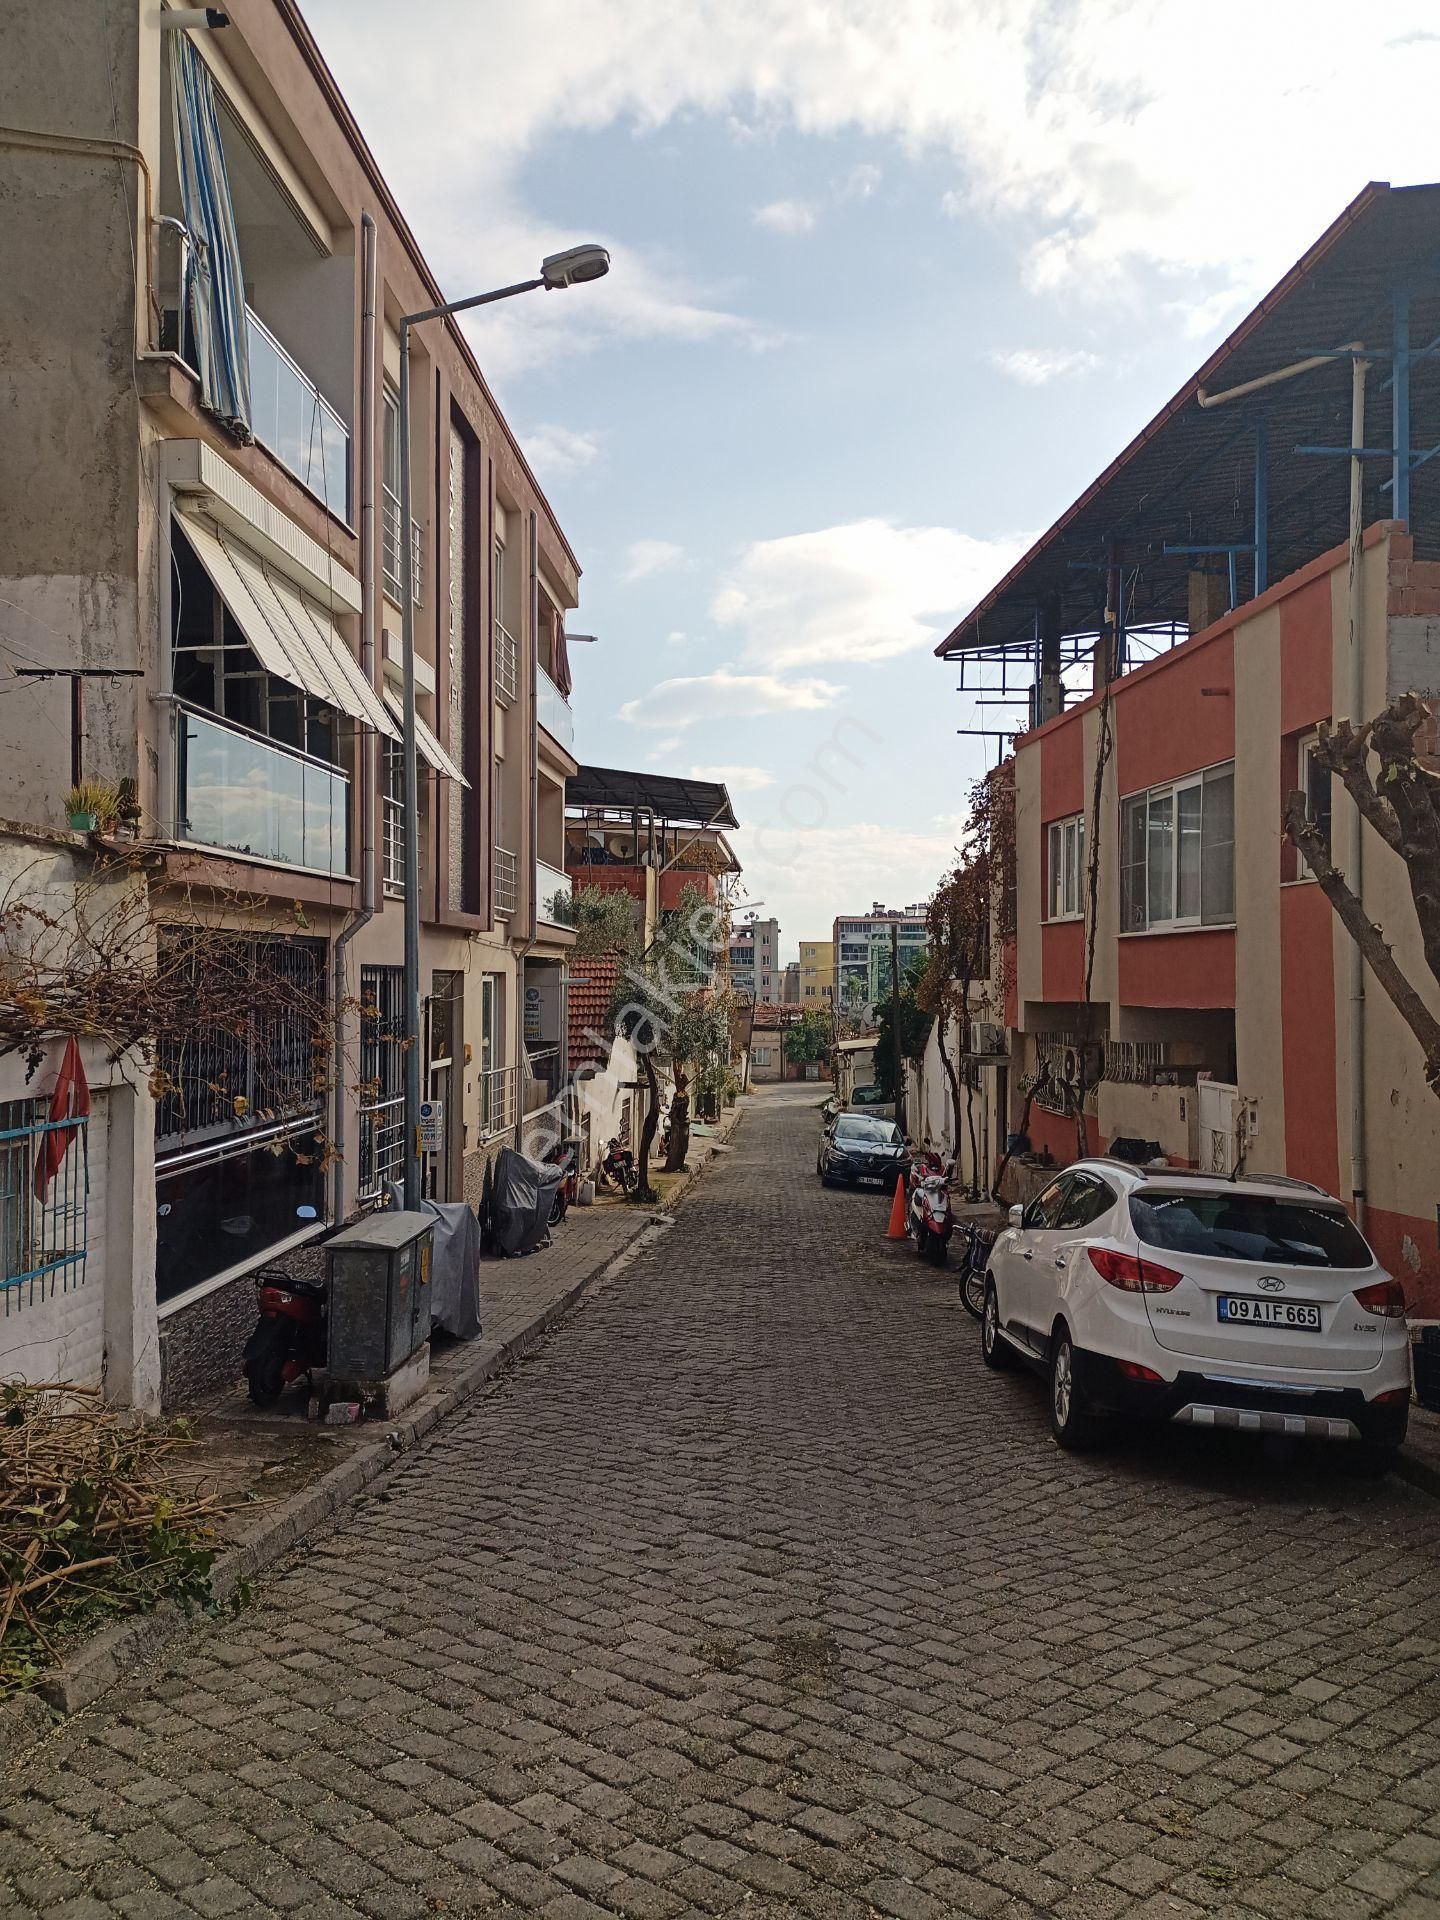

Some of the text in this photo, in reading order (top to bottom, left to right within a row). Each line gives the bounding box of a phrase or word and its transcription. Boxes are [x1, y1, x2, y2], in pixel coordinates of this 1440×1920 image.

[1228, 1300, 1317, 1325] 09 AIF 665
